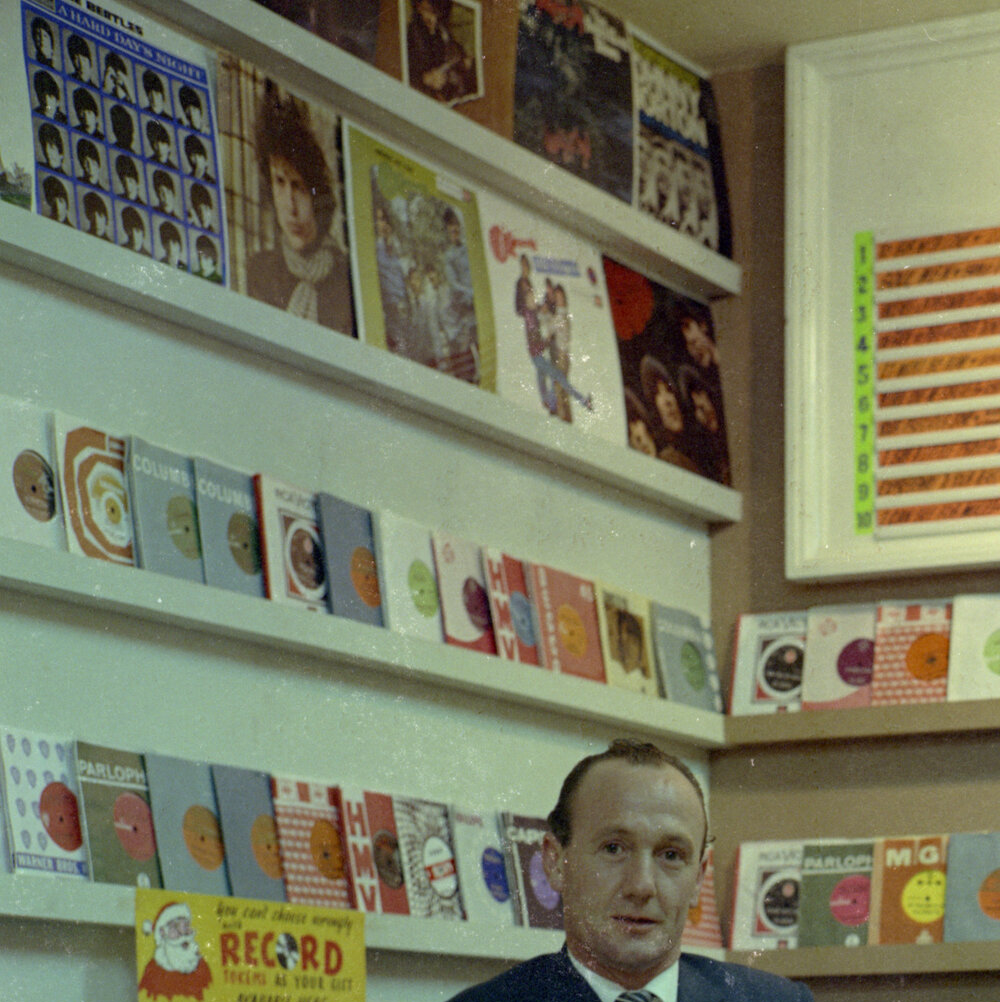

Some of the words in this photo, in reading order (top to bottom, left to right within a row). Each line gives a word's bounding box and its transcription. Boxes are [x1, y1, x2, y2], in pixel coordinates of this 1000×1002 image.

[69, 9, 112, 39] HARD
[154, 49, 204, 80] NIGHT
[220, 930, 344, 977] RECORD
[275, 974, 287, 987] AS
[294, 976, 324, 990] YOUR
